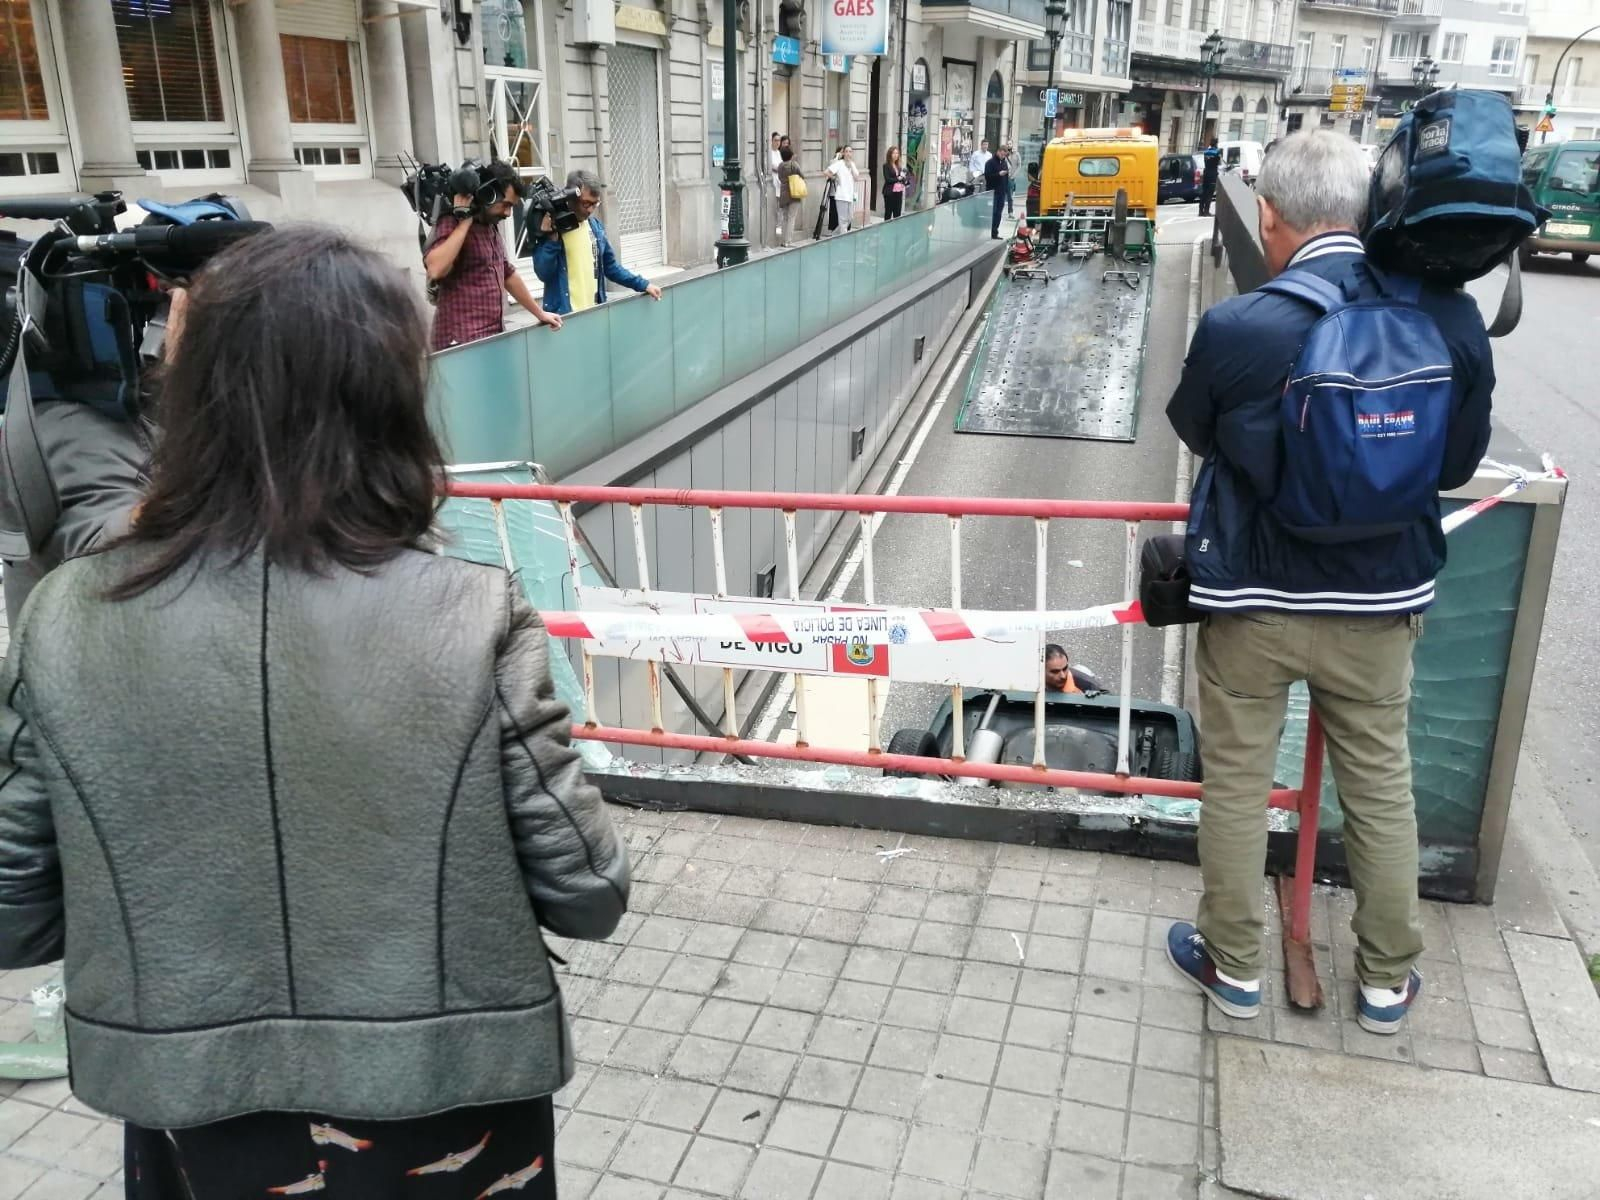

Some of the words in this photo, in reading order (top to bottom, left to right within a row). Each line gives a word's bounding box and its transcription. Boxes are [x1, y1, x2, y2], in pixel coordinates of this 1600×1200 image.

[834, 0, 875, 17] GAES
[1357, 413, 1382, 431] PAUL
[1383, 410, 1415, 430] FRANK
[793, 617, 834, 632] POLICIA
[839, 616, 853, 631] DE
[856, 616, 888, 631] LINEA
[755, 641, 803, 655] VIGO
